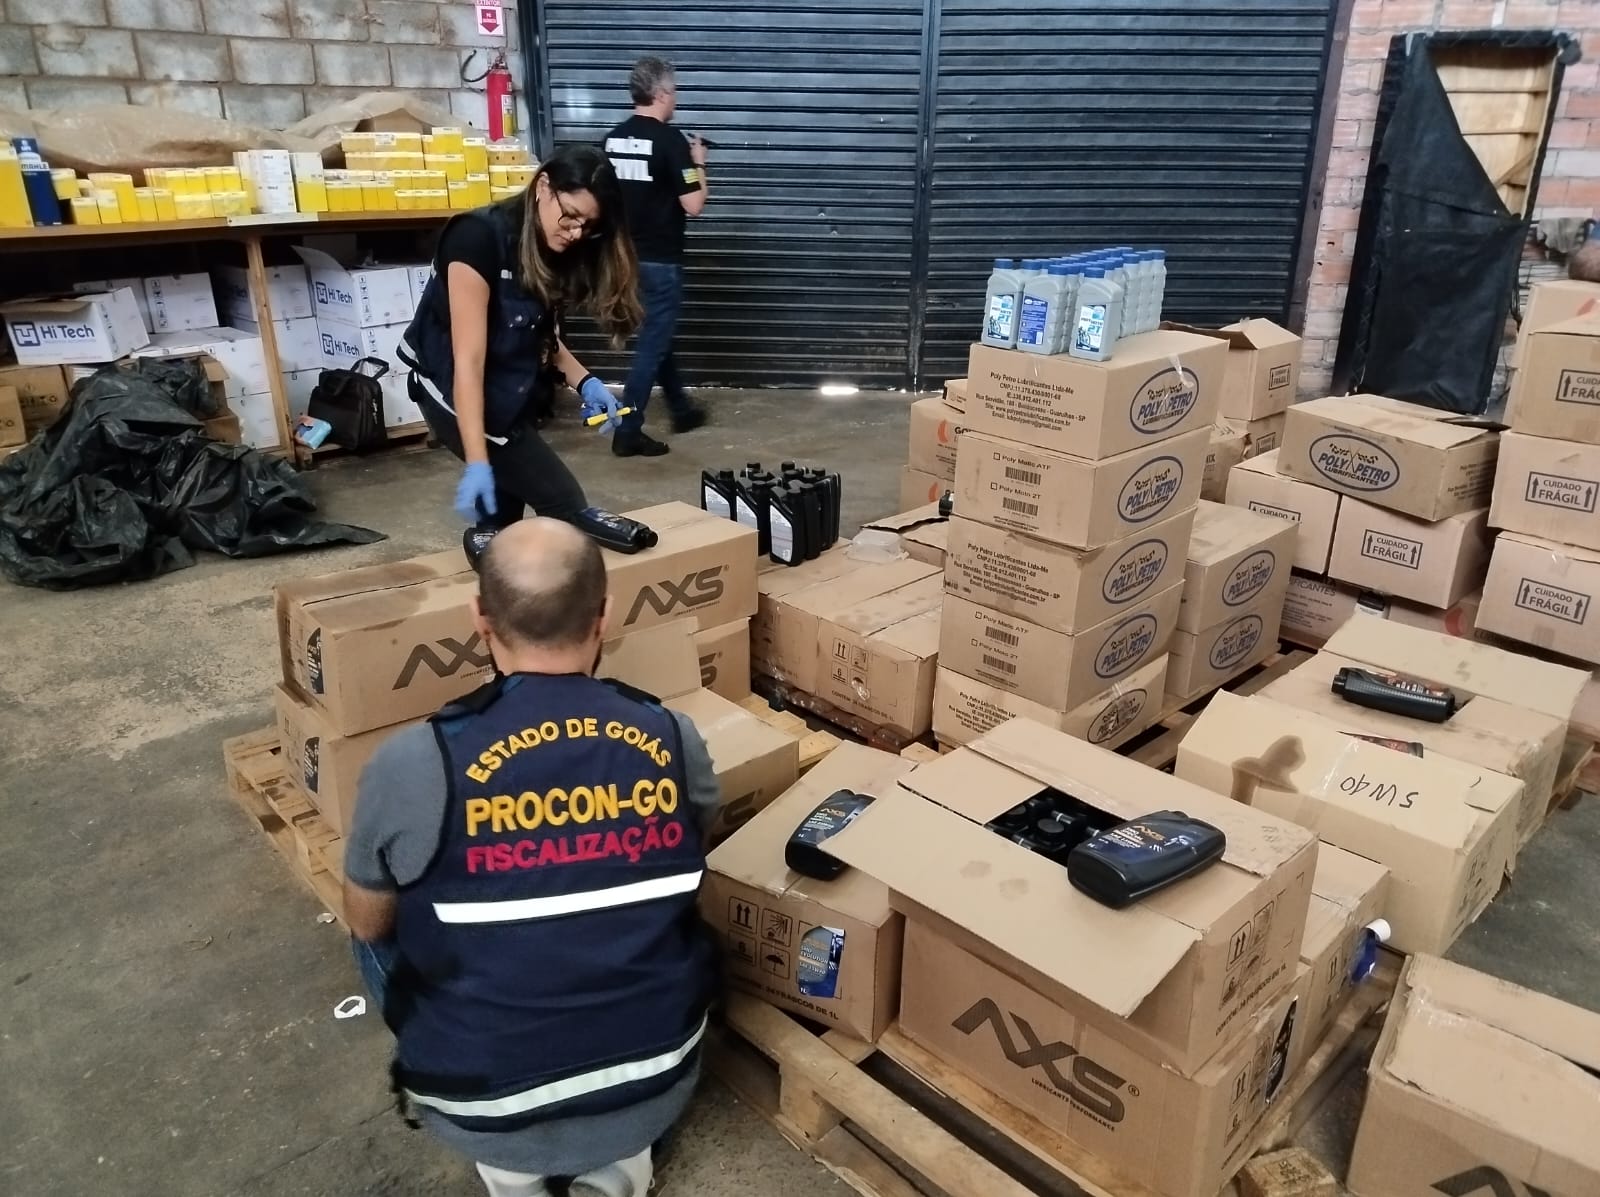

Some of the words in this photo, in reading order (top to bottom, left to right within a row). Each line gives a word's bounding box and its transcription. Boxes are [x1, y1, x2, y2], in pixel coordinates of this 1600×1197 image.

[328, 290, 337, 300] Hi
[337, 290, 353, 304] Tech
[40, 325, 57, 339] Hi
[58, 325, 95, 338] Tech
[334, 340, 342, 349] Hi
[342, 341, 360, 356] Tech
[1137, 399, 1162, 421] POLY
[1169, 391, 1193, 411] PETRO
[1002, 455, 1017, 464] Poly
[1036, 463, 1051, 471] ATF
[1318, 452, 1348, 469] POLY
[1354, 463, 1391, 483] PETRO
[1324, 465, 1379, 487] LUBRIFICANTES
[1543, 480, 1582, 492] CUIDADO
[999, 484, 1014, 494] Poly
[1124, 489, 1151, 511] POLY
[1153, 477, 1178, 497] PETRO
[1538, 489, 1582, 505] FRÁGIL
[1259, 508, 1289, 520] CUIDADO
[1372, 544, 1408, 563] FRÁGIL
[1376, 537, 1409, 550] CUIDADO
[1108, 572, 1135, 594] POLY
[1138, 558, 1162, 579] PETRO
[1250, 566, 1271, 583] PETRO
[622, 565, 724, 627] AXS
[1534, 587, 1573, 603] CUIDADO
[1529, 596, 1571, 616] FRÁGIL
[1129, 631, 1152, 652] PETRO
[391, 631, 492, 691] AX
[465, 721, 560, 784] ESTADO
[565, 717, 599, 739] DE
[605, 721, 672, 768] GOIÁS
[465, 778, 678, 837] PROCON-GO
[466, 816, 683, 874] FISCALIZAÇÃO
[828, 1010, 839, 1020] 1L
[951, 997, 1127, 1123] AXS
[1069, 1100, 1116, 1132] PERFORMANCE
